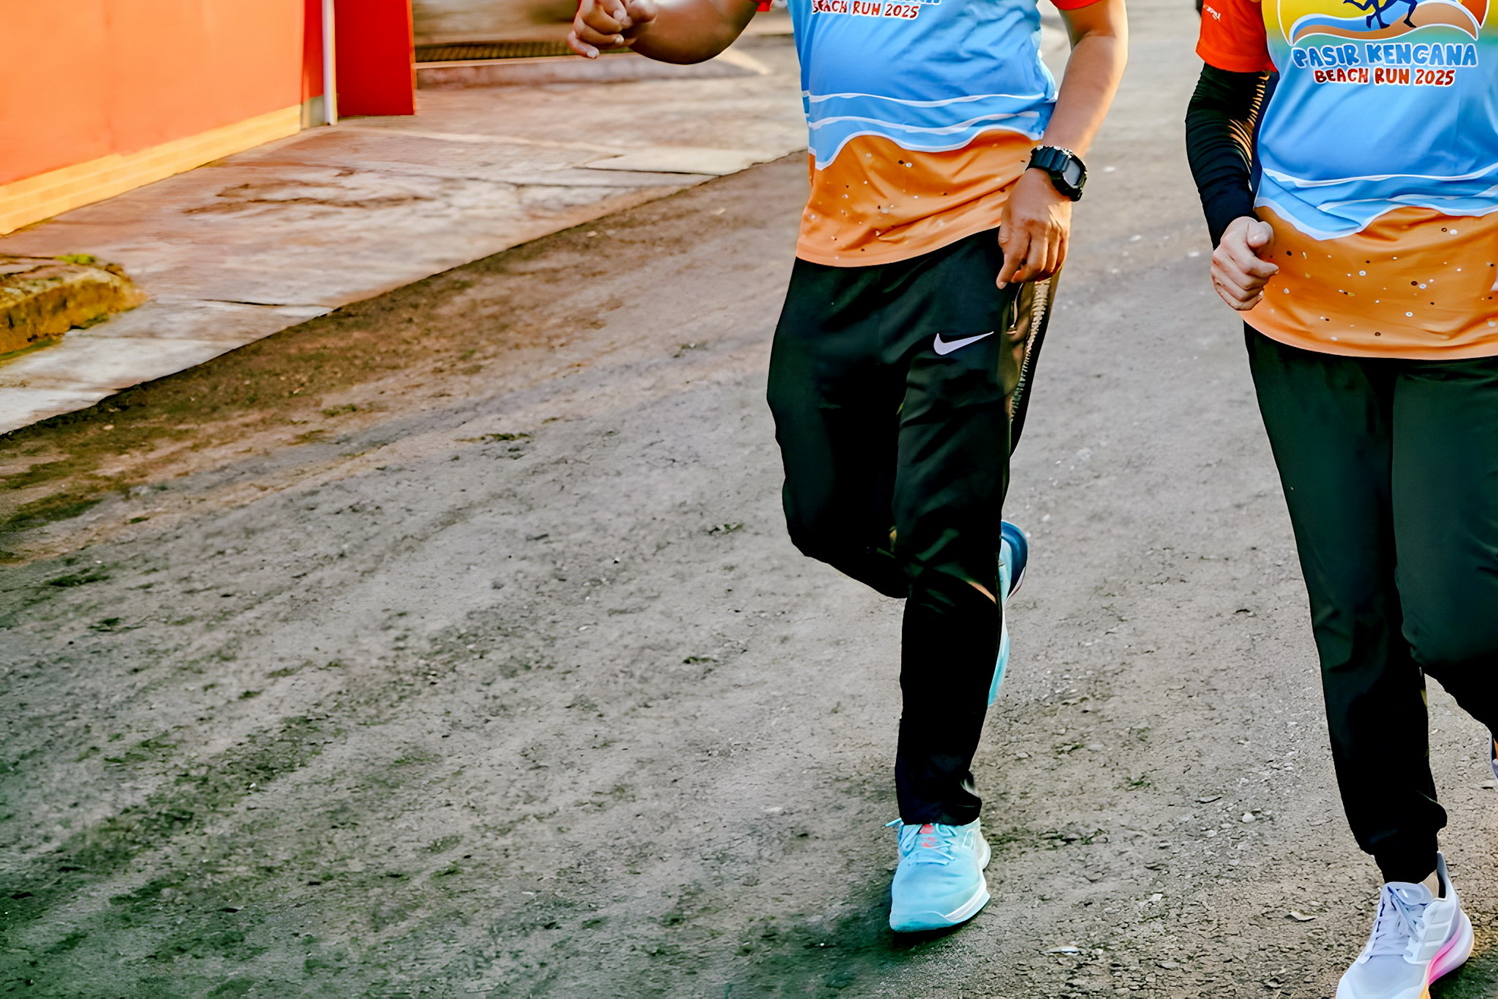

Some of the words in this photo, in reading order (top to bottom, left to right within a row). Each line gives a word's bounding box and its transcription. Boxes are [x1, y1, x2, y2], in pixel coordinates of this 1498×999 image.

[852, 0, 881, 16] RUN
[884, 3, 920, 19] 2025
[1292, 43, 1361, 67] PASIR
[1365, 43, 1479, 67] KENCANA
[1314, 68, 1369, 84] BEACH
[1374, 68, 1411, 85] RUN
[1414, 69, 1456, 86] 2025
